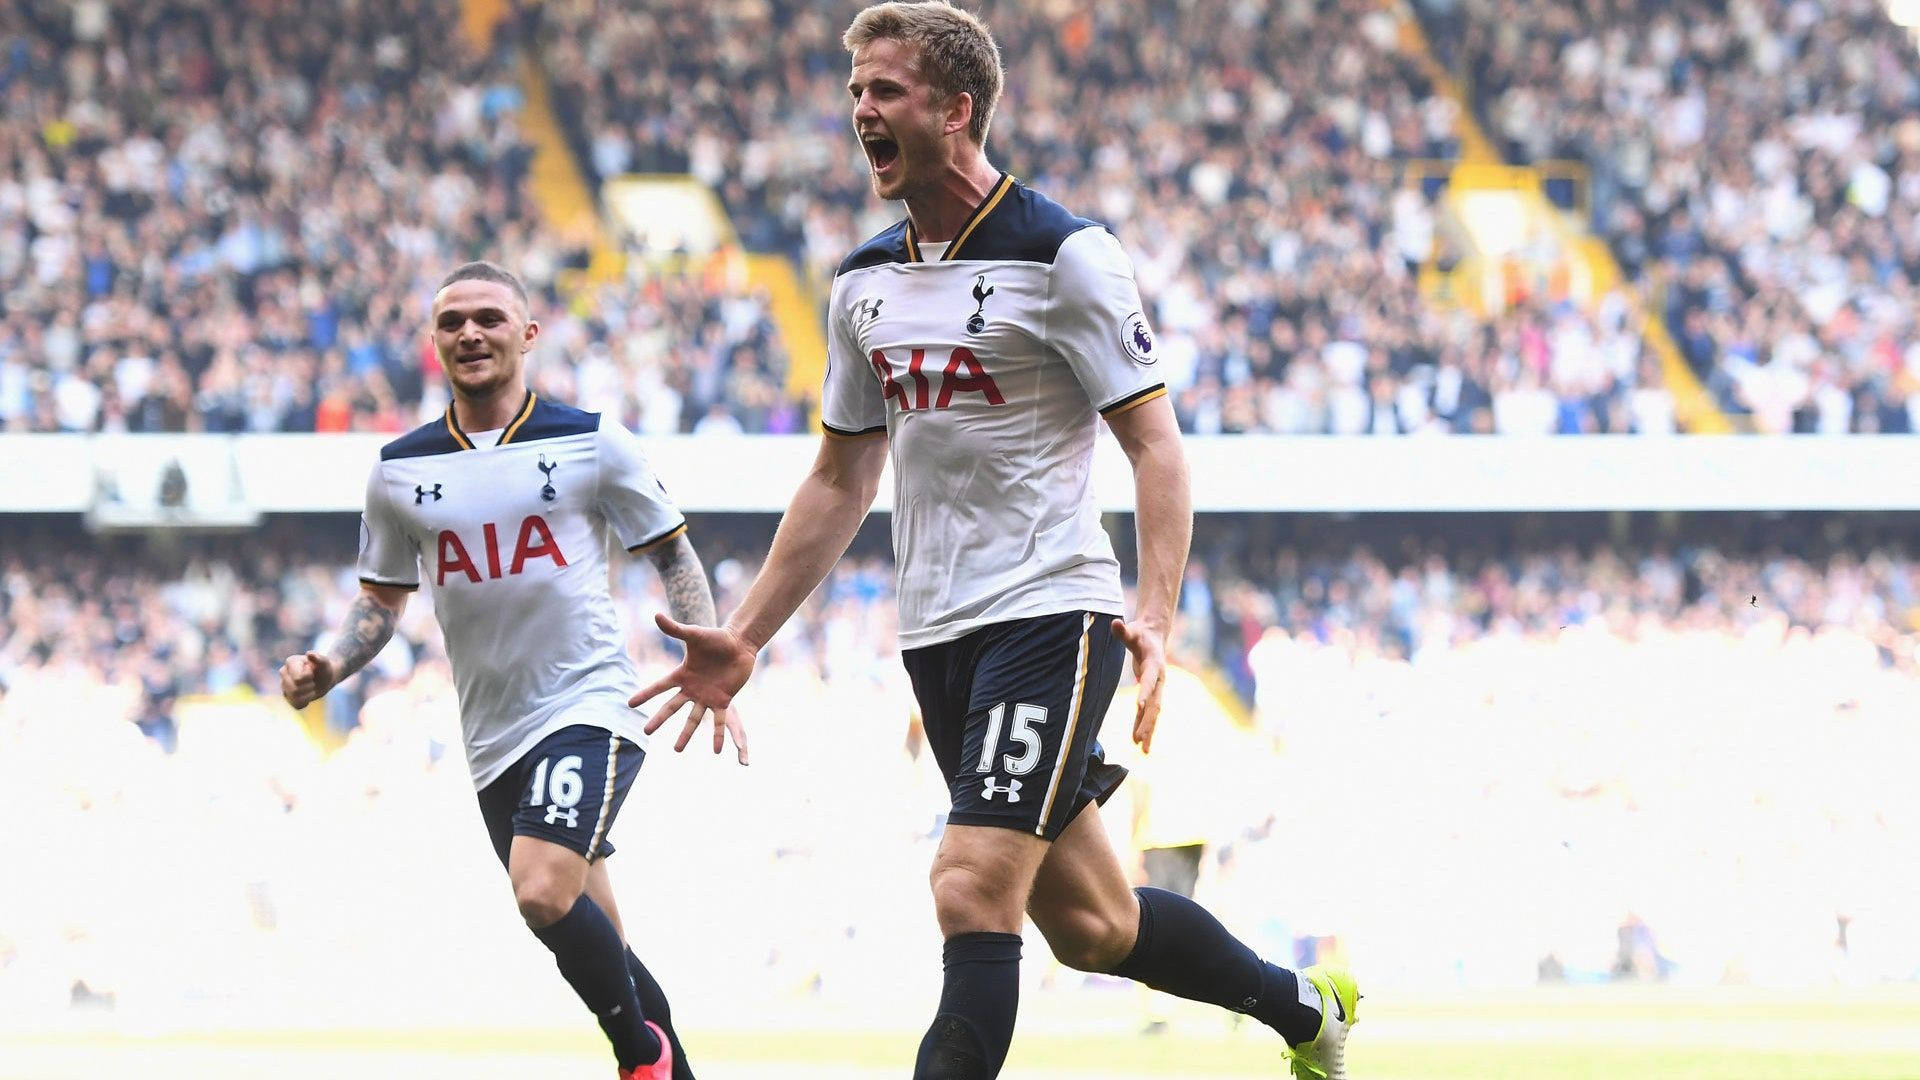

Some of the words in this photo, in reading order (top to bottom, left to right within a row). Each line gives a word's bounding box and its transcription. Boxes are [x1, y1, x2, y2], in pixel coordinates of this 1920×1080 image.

[871, 347, 1006, 411] AIA
[437, 514, 569, 587] AIA
[976, 702, 1048, 775] 15
[529, 754, 584, 808] 16
